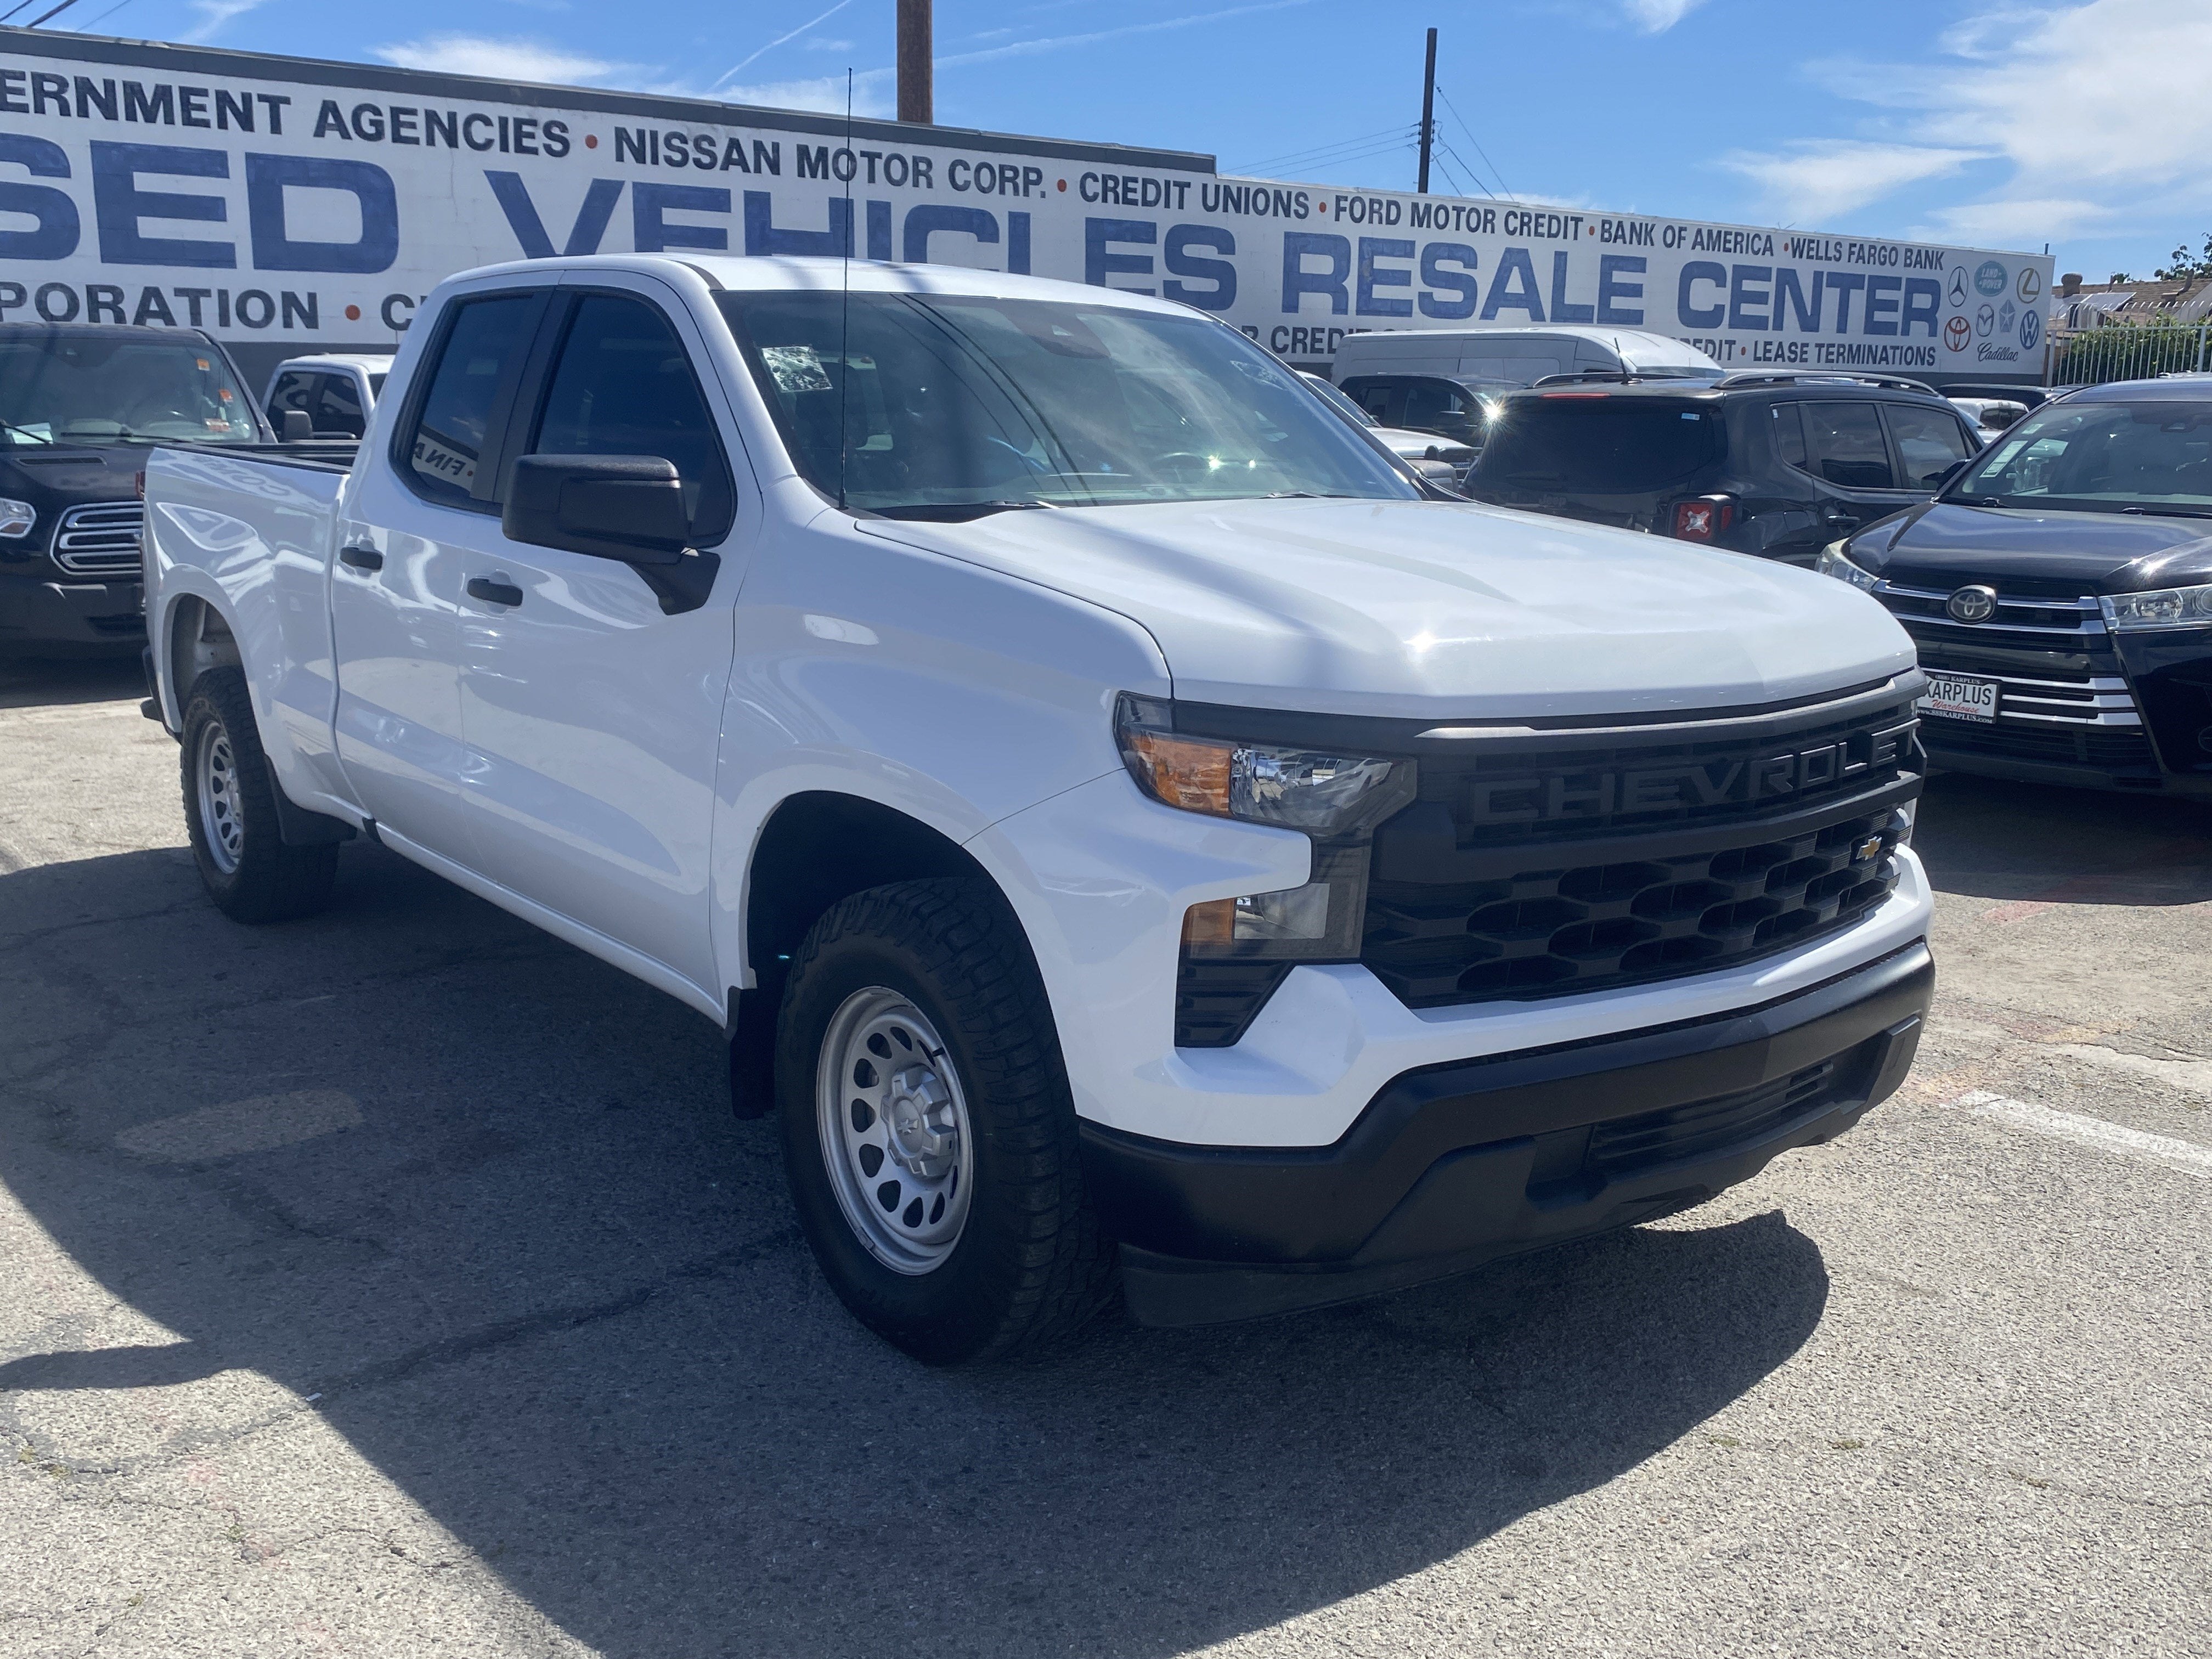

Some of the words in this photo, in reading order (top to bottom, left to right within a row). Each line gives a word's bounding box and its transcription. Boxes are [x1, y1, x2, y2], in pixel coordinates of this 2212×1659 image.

[0, 69, 291, 135] ERNMENT
[313, 99, 571, 157] AGENCIES
[614, 126, 781, 176] NISSAN
[796, 144, 934, 189] MOTOR
[948, 159, 1046, 199] CORP.
[1079, 172, 1191, 210] CREDIT
[1201, 183, 1310, 219] UNIONS
[1334, 195, 1401, 225] FORD
[1410, 201, 1496, 234] MOTOR
[1504, 210, 1584, 241] CREDIT
[1600, 219, 1656, 247] BANK
[1662, 224, 1688, 249] OF
[1691, 227, 1774, 257] AMERICA
[1790, 236, 1842, 262] WELLS
[1847, 242, 1899, 267] FARGO
[1903, 247, 1945, 271] BANK
[1281, 231, 1647, 325] RESALE
[1677, 261, 1941, 337] CENTER
[0, 281, 320, 329] PORATION
[1271, 325, 1372, 354] CRED
[1753, 340, 1809, 363] LEASE
[1814, 343, 1937, 366] TERMINATIONS
[1977, 342, 2018, 362] Cadillac
[1931, 699, 1980, 714] Warehouse
